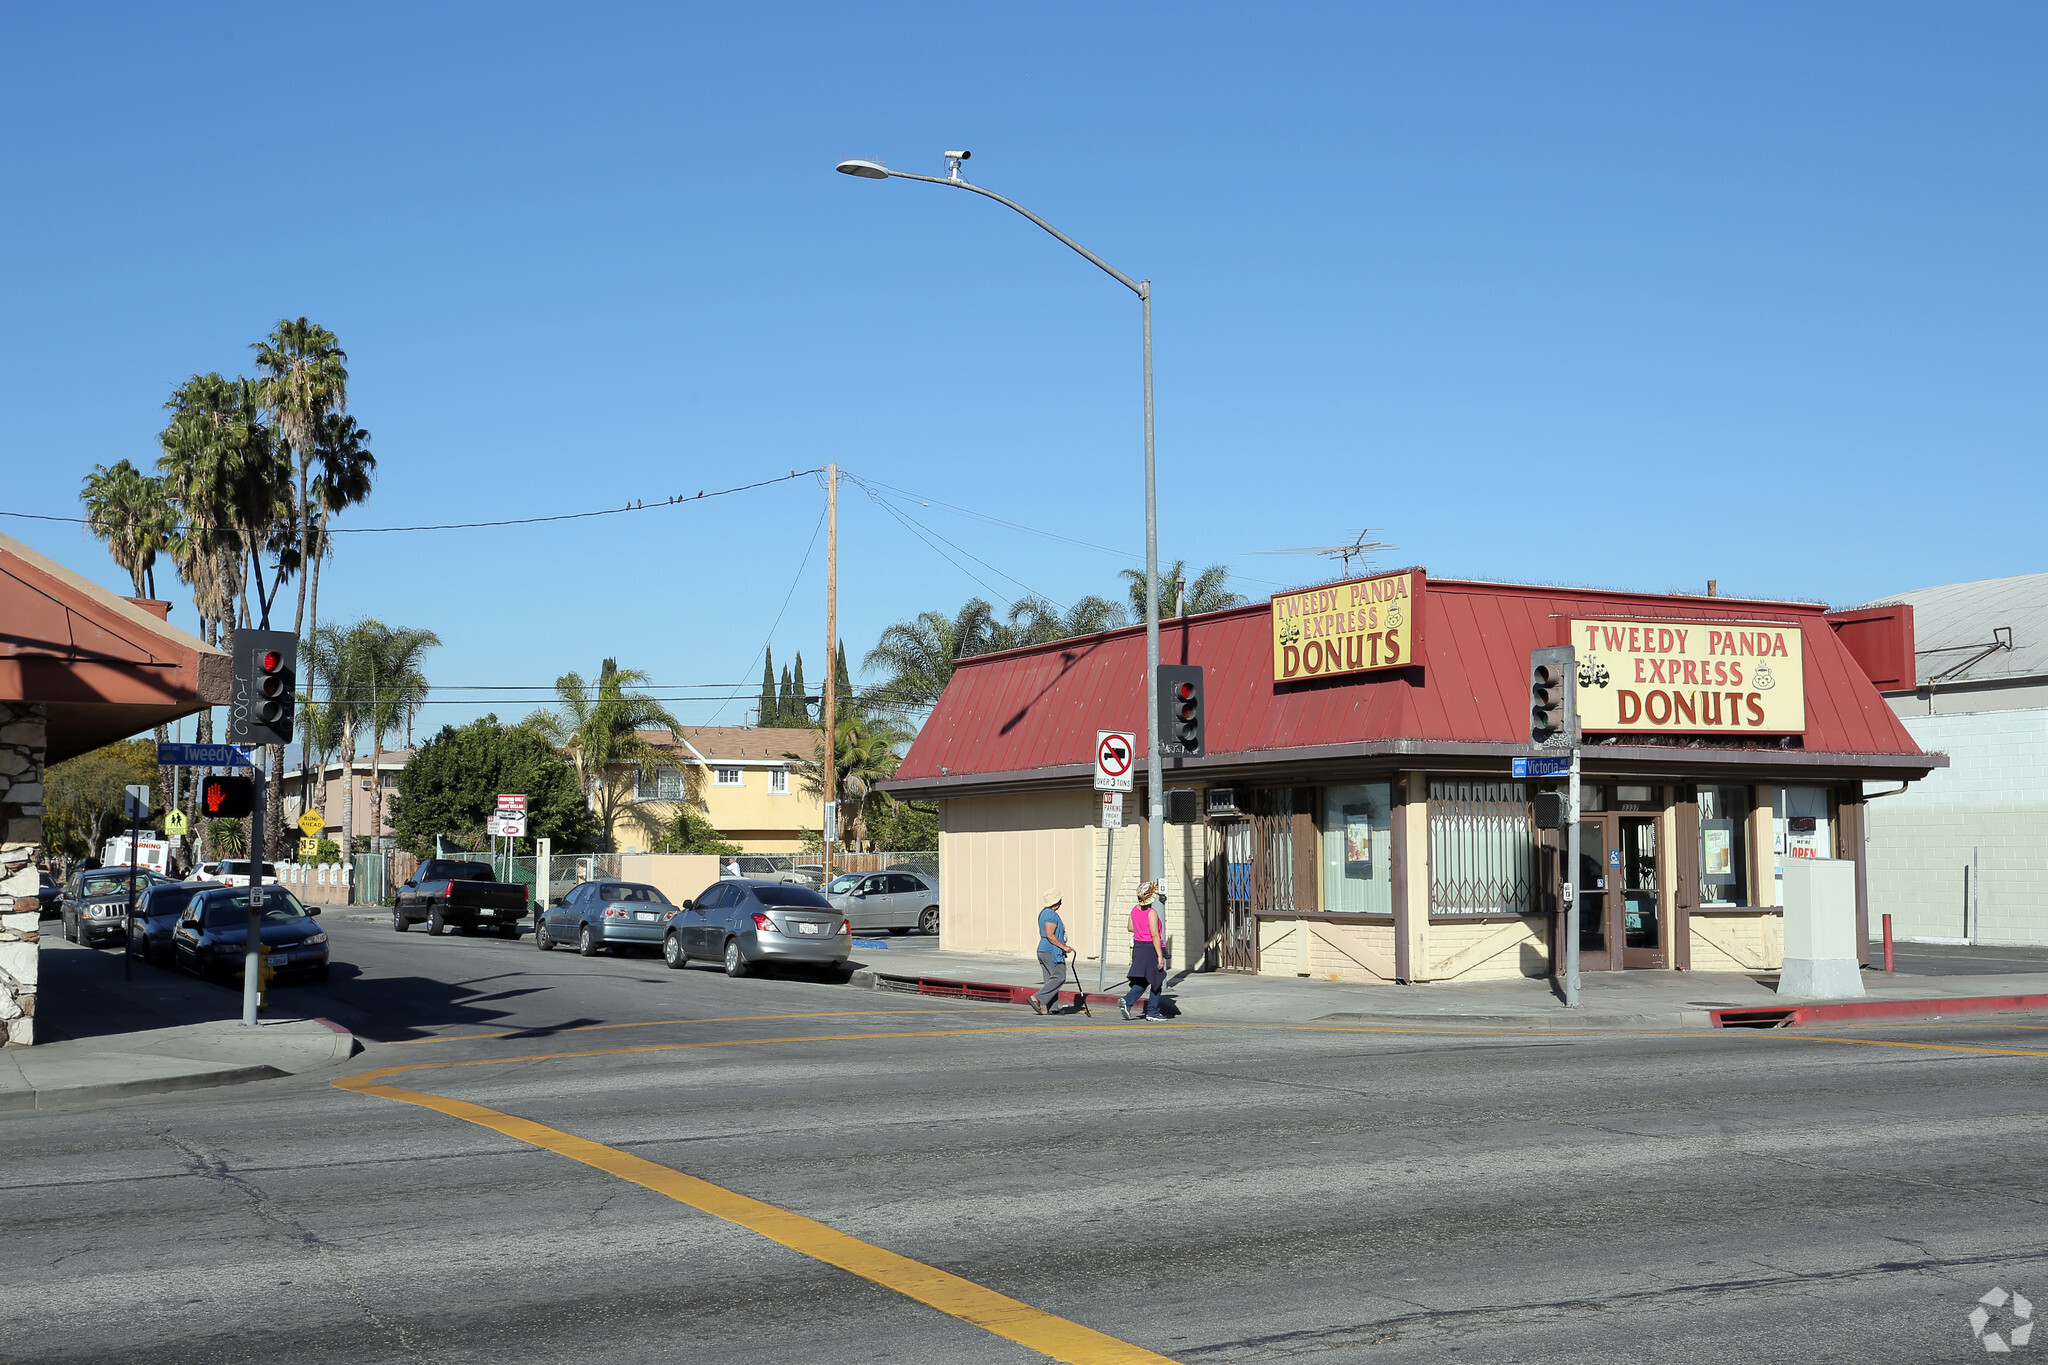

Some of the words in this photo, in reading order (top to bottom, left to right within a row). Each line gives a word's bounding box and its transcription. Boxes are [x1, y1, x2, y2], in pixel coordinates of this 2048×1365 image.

[1276, 589, 1338, 619] TWEEDY
[1350, 577, 1408, 607] PANDA
[1303, 606, 1378, 640] EXPRESS
[1282, 629, 1400, 677] DONUTS
[1585, 625, 1689, 654] TWEEDY
[1708, 630, 1789, 657] PANDA
[1634, 658, 1743, 686] EXPRESS
[1617, 689, 1765, 726] DONUTS
[182, 744, 234, 765] Tweedy
[1527, 759, 1559, 774] Victoria
[1096, 778, 1110, 786] OVER
[1110, 778, 1116, 786] 3
[1117, 779, 1130, 787] TONS
[1104, 794, 1112, 802] NO
[1776, 835, 1782, 845] A
[1792, 846, 1816, 858] OPEN
